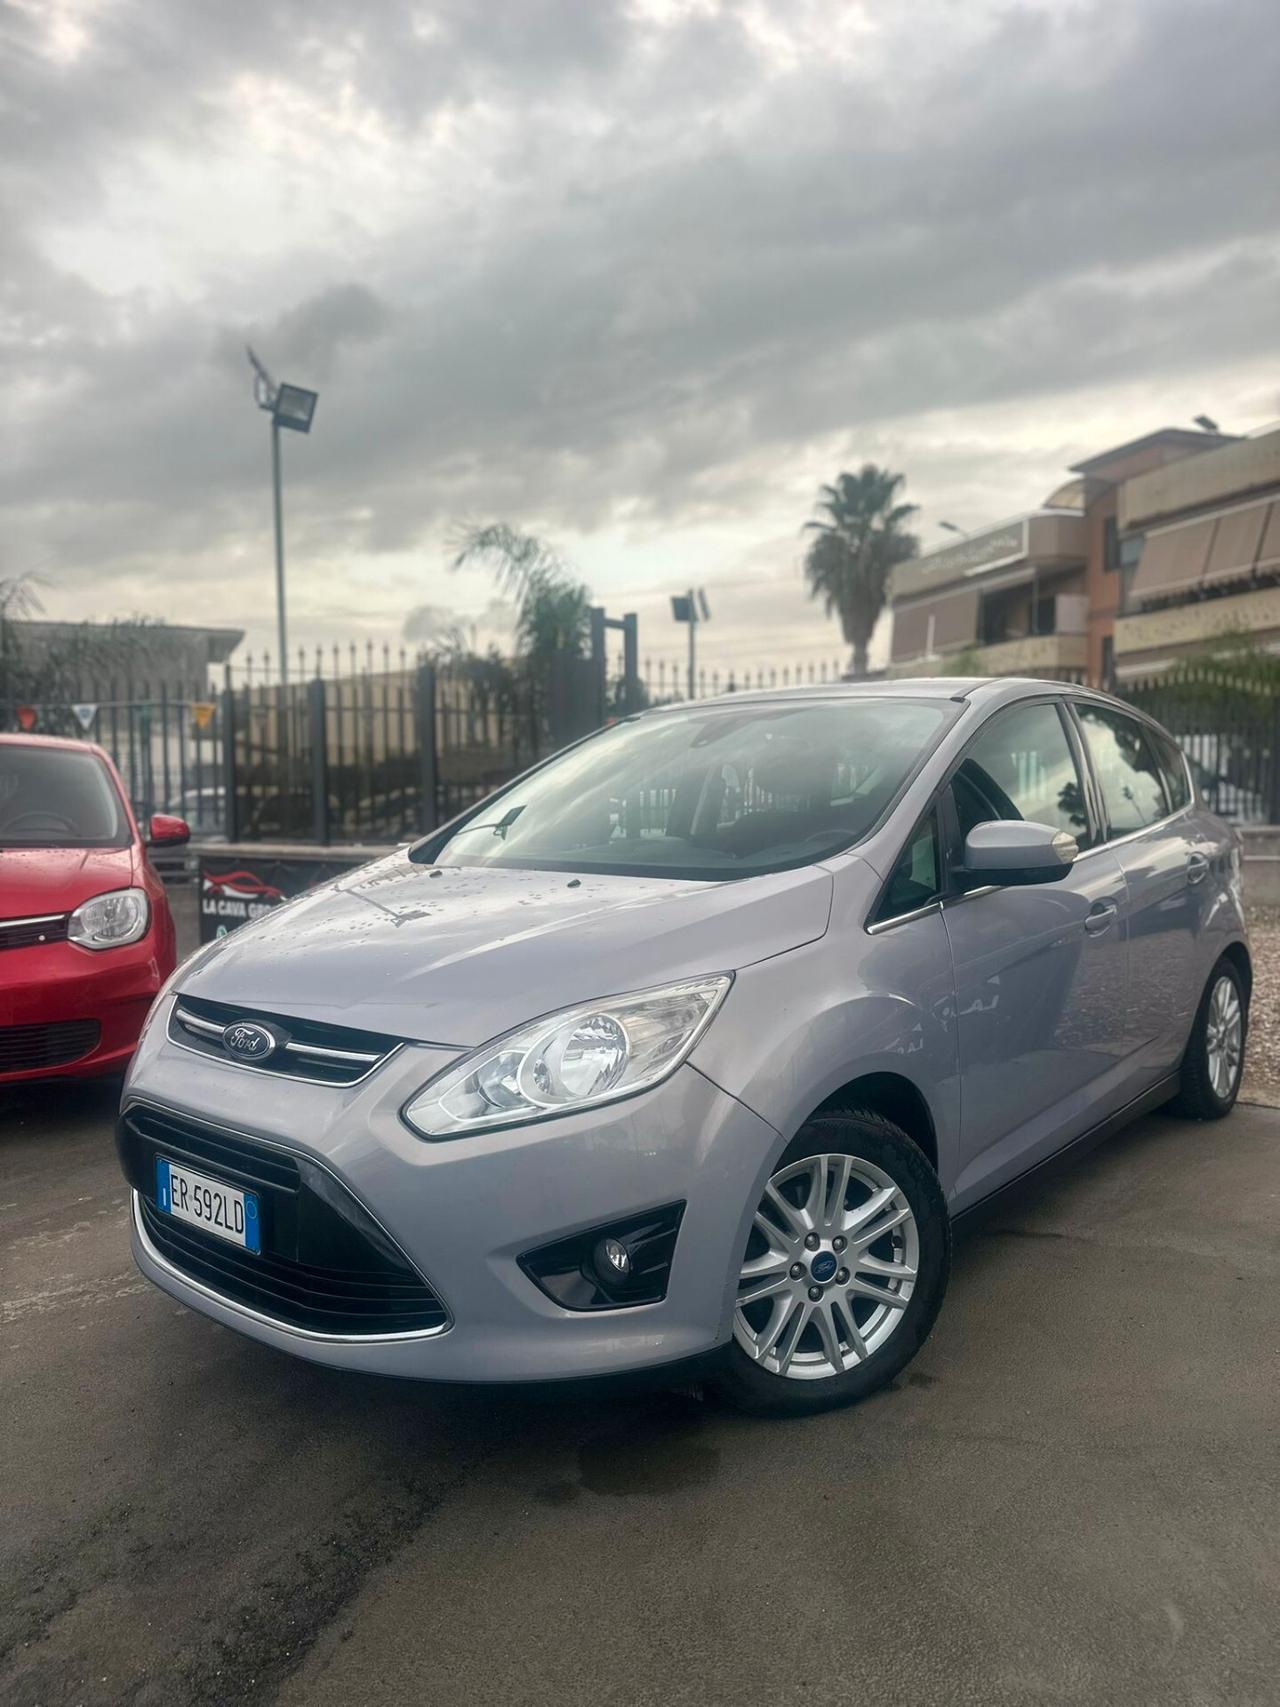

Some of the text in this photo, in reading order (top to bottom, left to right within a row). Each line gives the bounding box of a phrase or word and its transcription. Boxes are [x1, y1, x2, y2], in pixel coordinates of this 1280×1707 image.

[203, 899, 216, 915] LA
[218, 900, 246, 918] CAVA
[230, 1027, 260, 1051] Ford
[170, 1174, 244, 1234] ER 592LD
